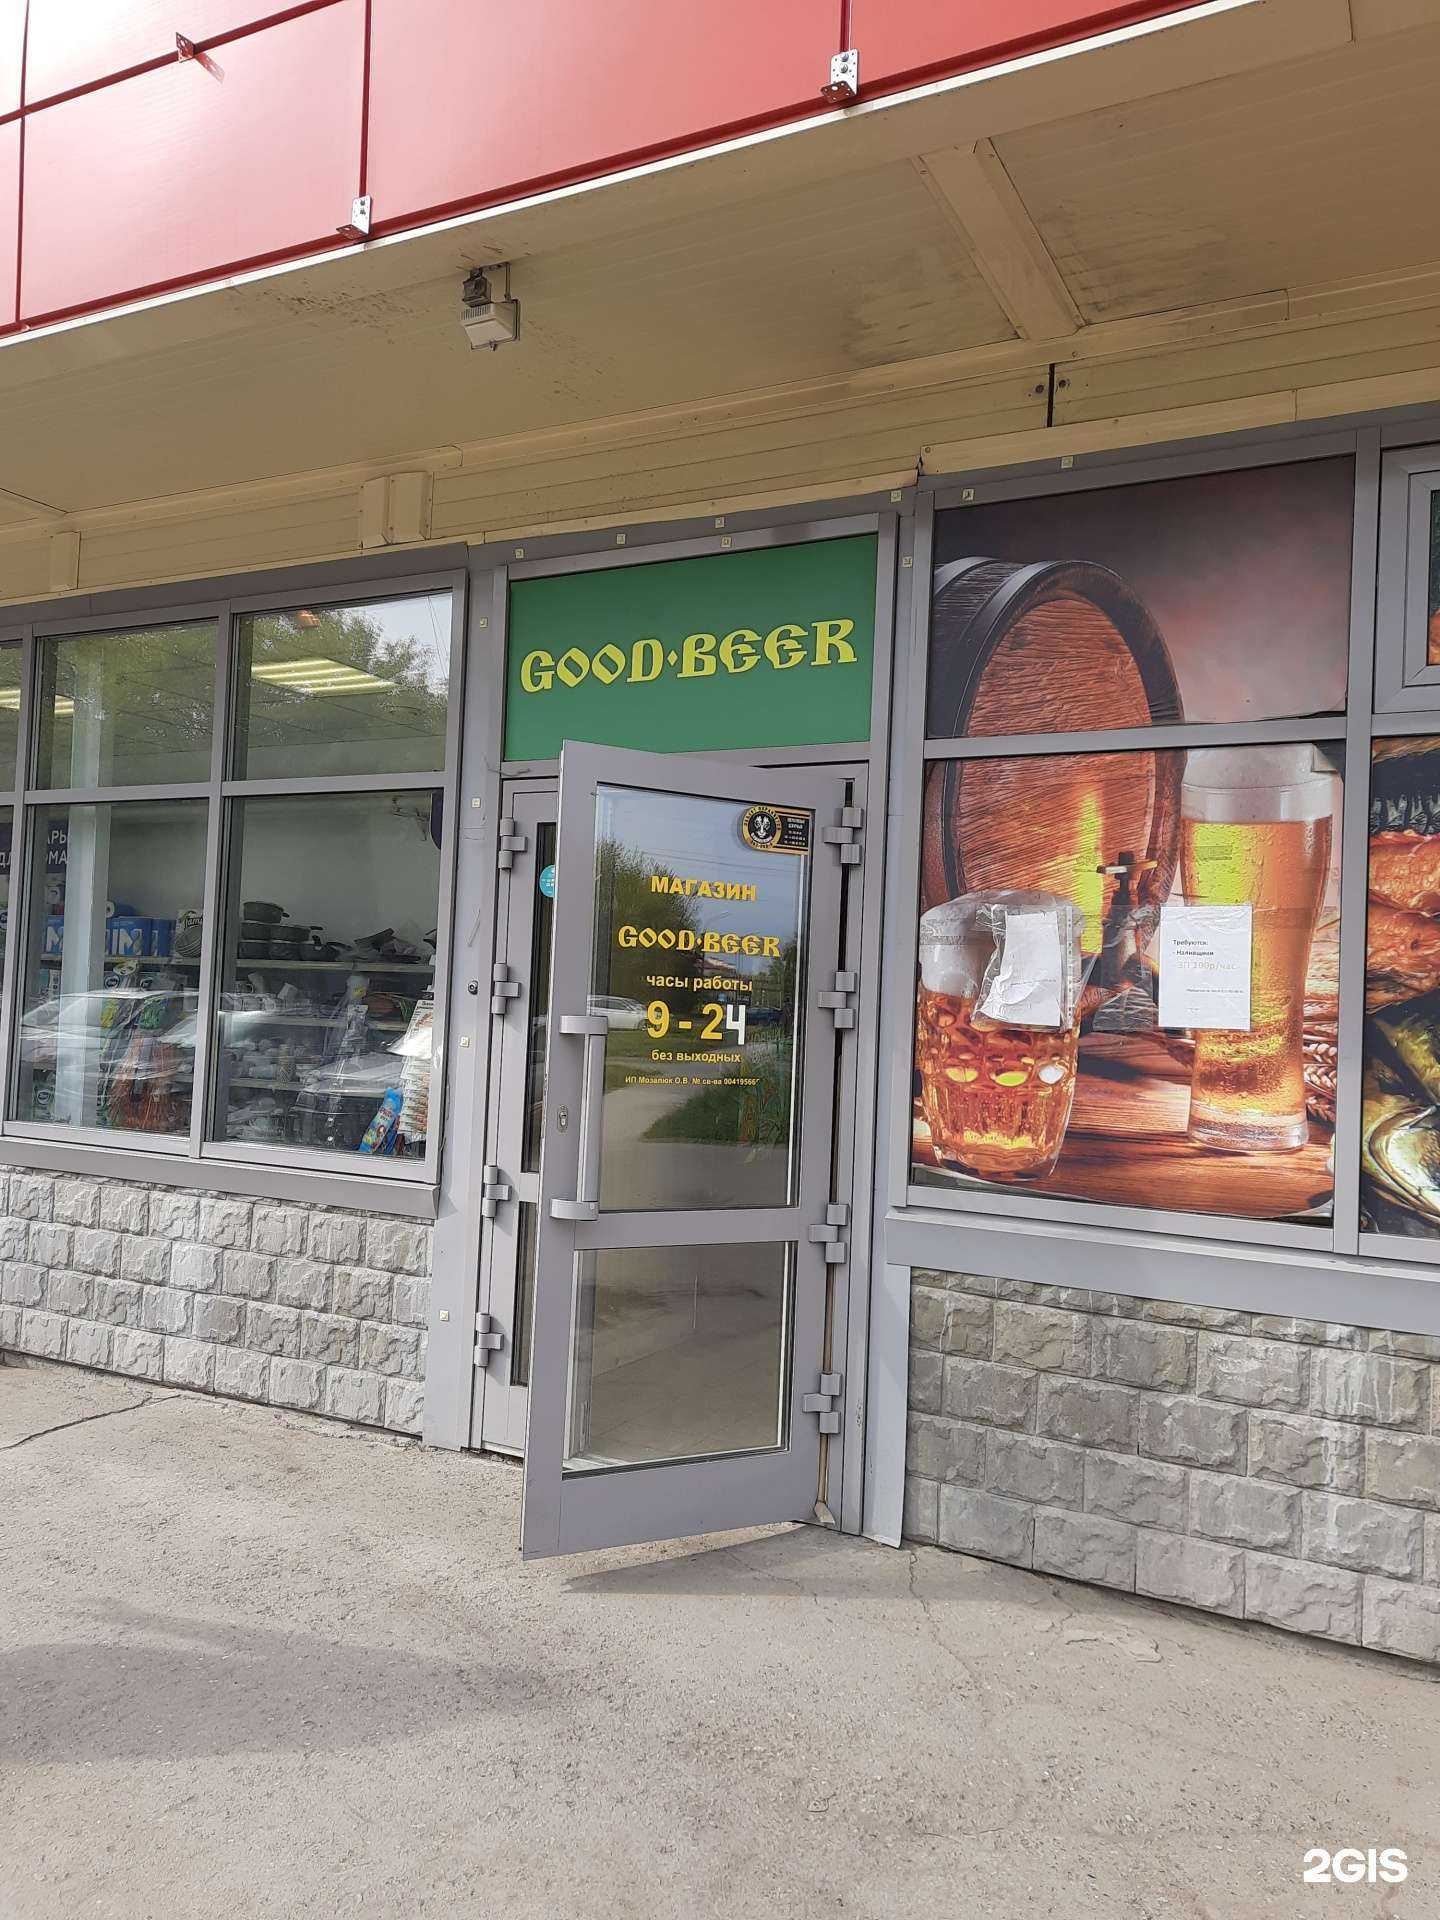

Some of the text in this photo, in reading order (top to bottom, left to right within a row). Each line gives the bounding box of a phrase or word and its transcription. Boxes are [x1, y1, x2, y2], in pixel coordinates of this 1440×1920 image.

[651, 875, 758, 901] МАГАЗИН
[646, 976, 753, 992] часы работы
[647, 1000, 670, 1038] 9
[701, 1003, 746, 1046] 24
[651, 1049, 742, 1064] без выходных
[625, 1075, 637, 1084] ИП
